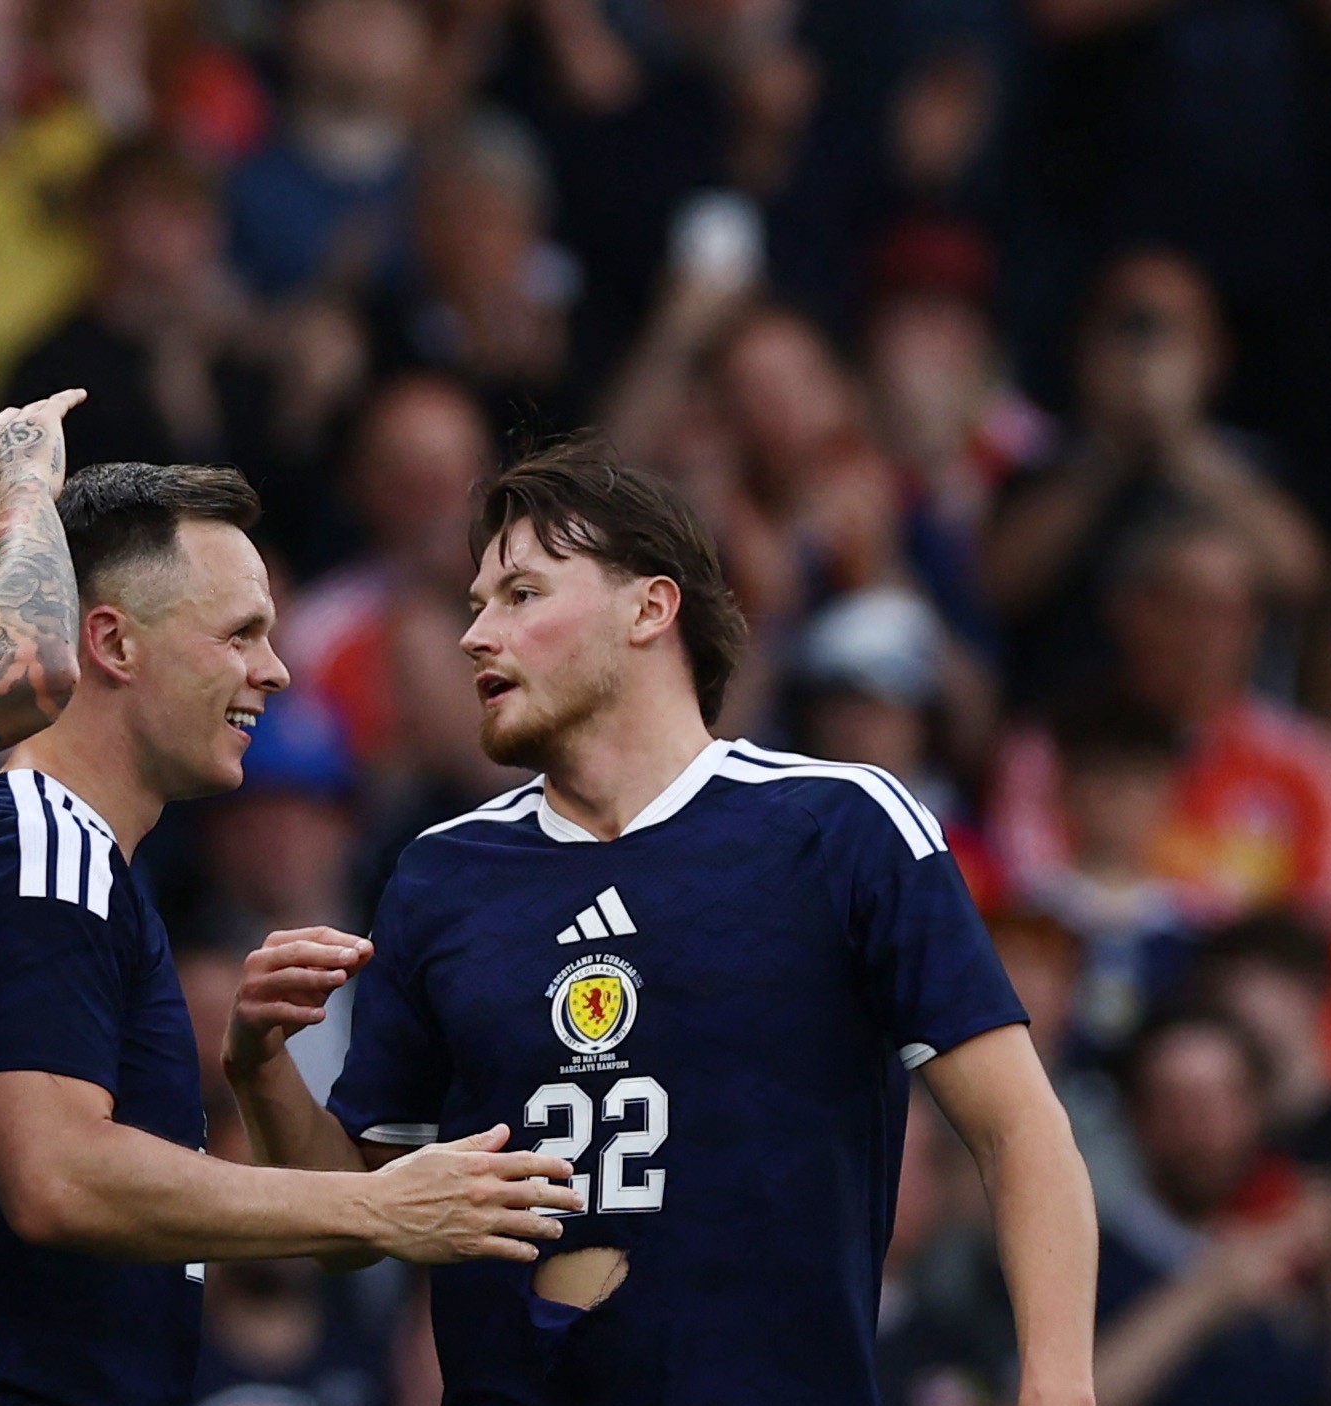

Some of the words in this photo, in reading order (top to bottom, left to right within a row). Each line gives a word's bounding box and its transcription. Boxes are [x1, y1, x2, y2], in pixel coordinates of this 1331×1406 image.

[553, 954, 594, 984] SCOTLAND
[595, 954, 601, 962] V
[575, 966, 616, 980] SCOTLAND
[583, 1055, 597, 1063] MAY
[560, 1063, 595, 1074] BARCLAYS
[524, 1076, 668, 1218] 22
